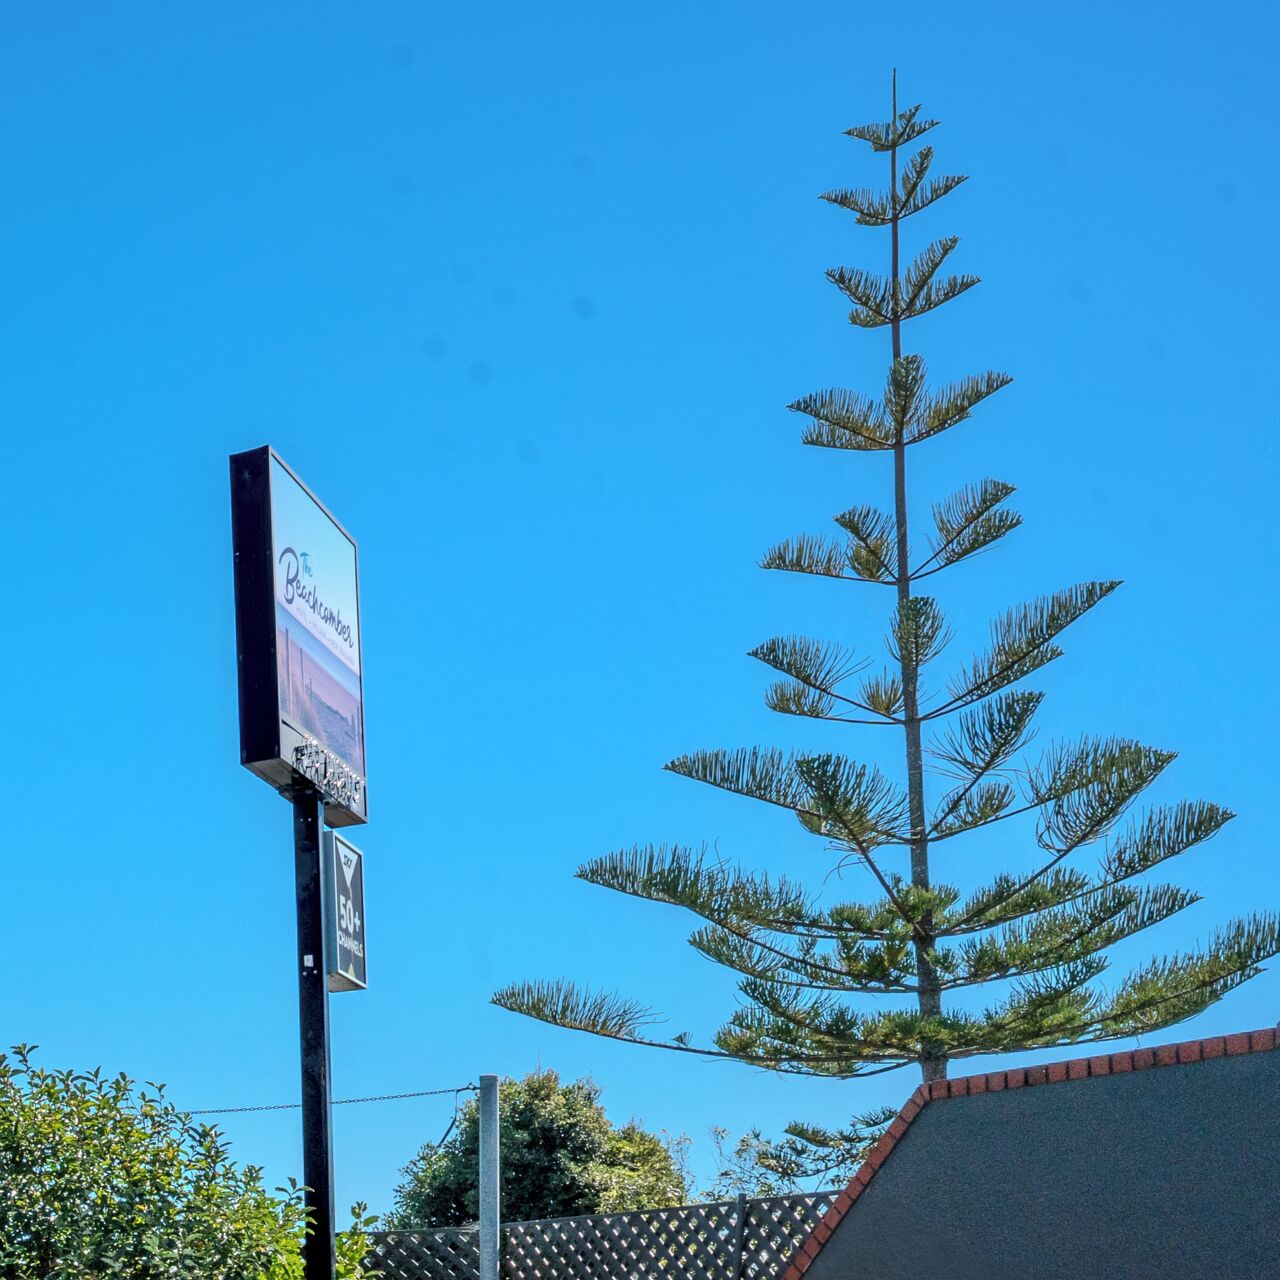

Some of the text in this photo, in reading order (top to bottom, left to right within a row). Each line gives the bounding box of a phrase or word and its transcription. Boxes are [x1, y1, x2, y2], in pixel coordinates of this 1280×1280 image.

[300, 552, 314, 578] The
[279, 547, 354, 648] Beachcomber
[340, 894, 361, 934] 50+
[338, 930, 363, 958] CHANNELS
